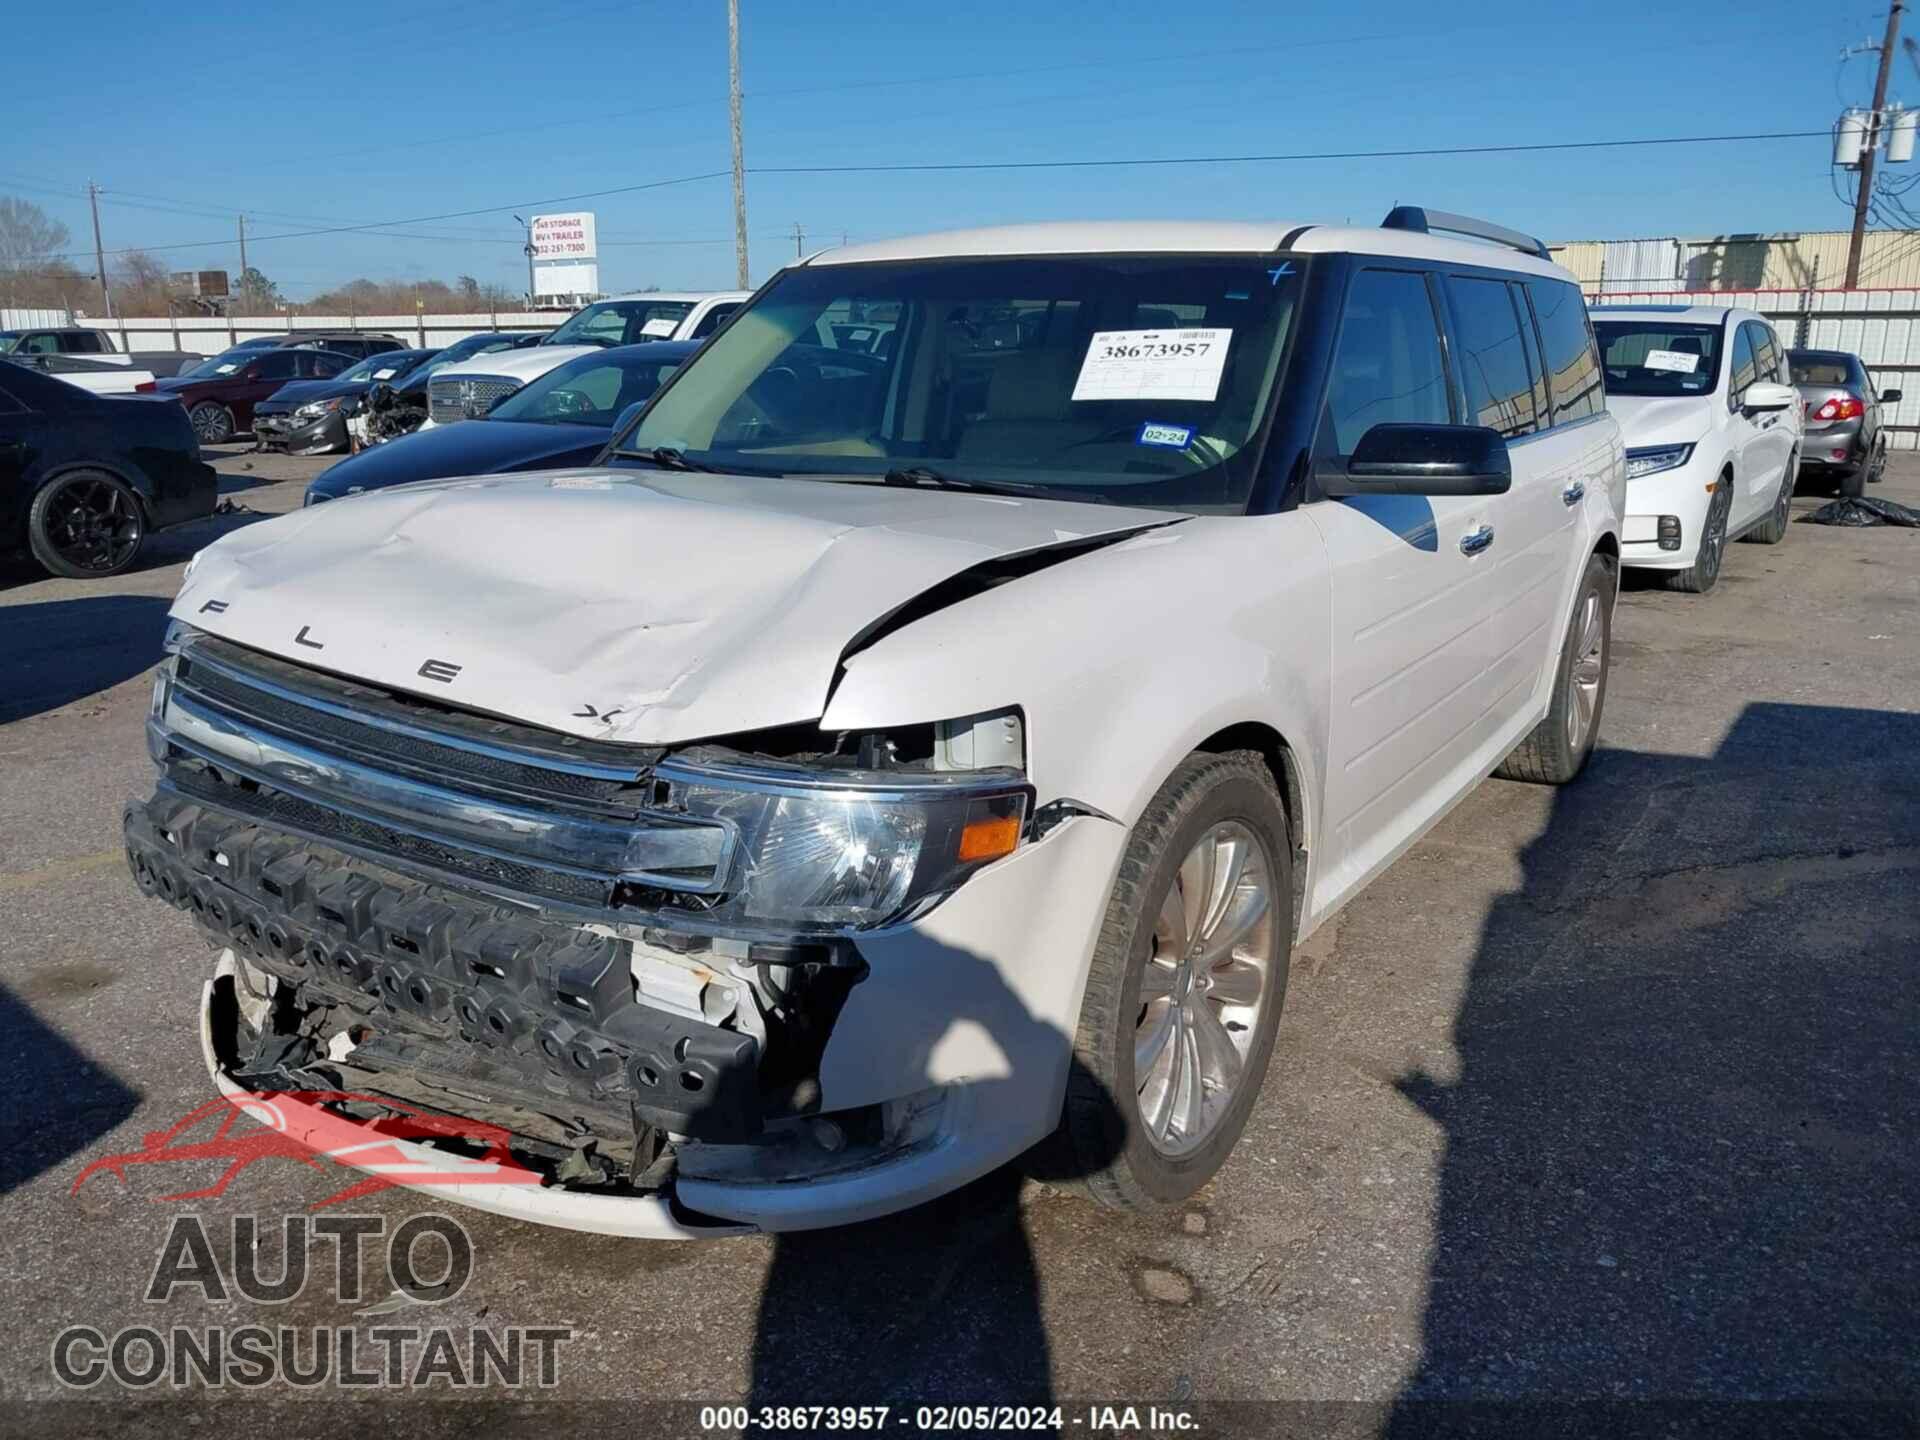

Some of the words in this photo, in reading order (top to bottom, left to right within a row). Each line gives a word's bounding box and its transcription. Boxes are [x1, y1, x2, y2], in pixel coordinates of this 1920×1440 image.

[550, 218, 581, 228] STORAGE
[551, 231, 583, 241] TRAILER
[1100, 343, 1210, 359] 38673957
